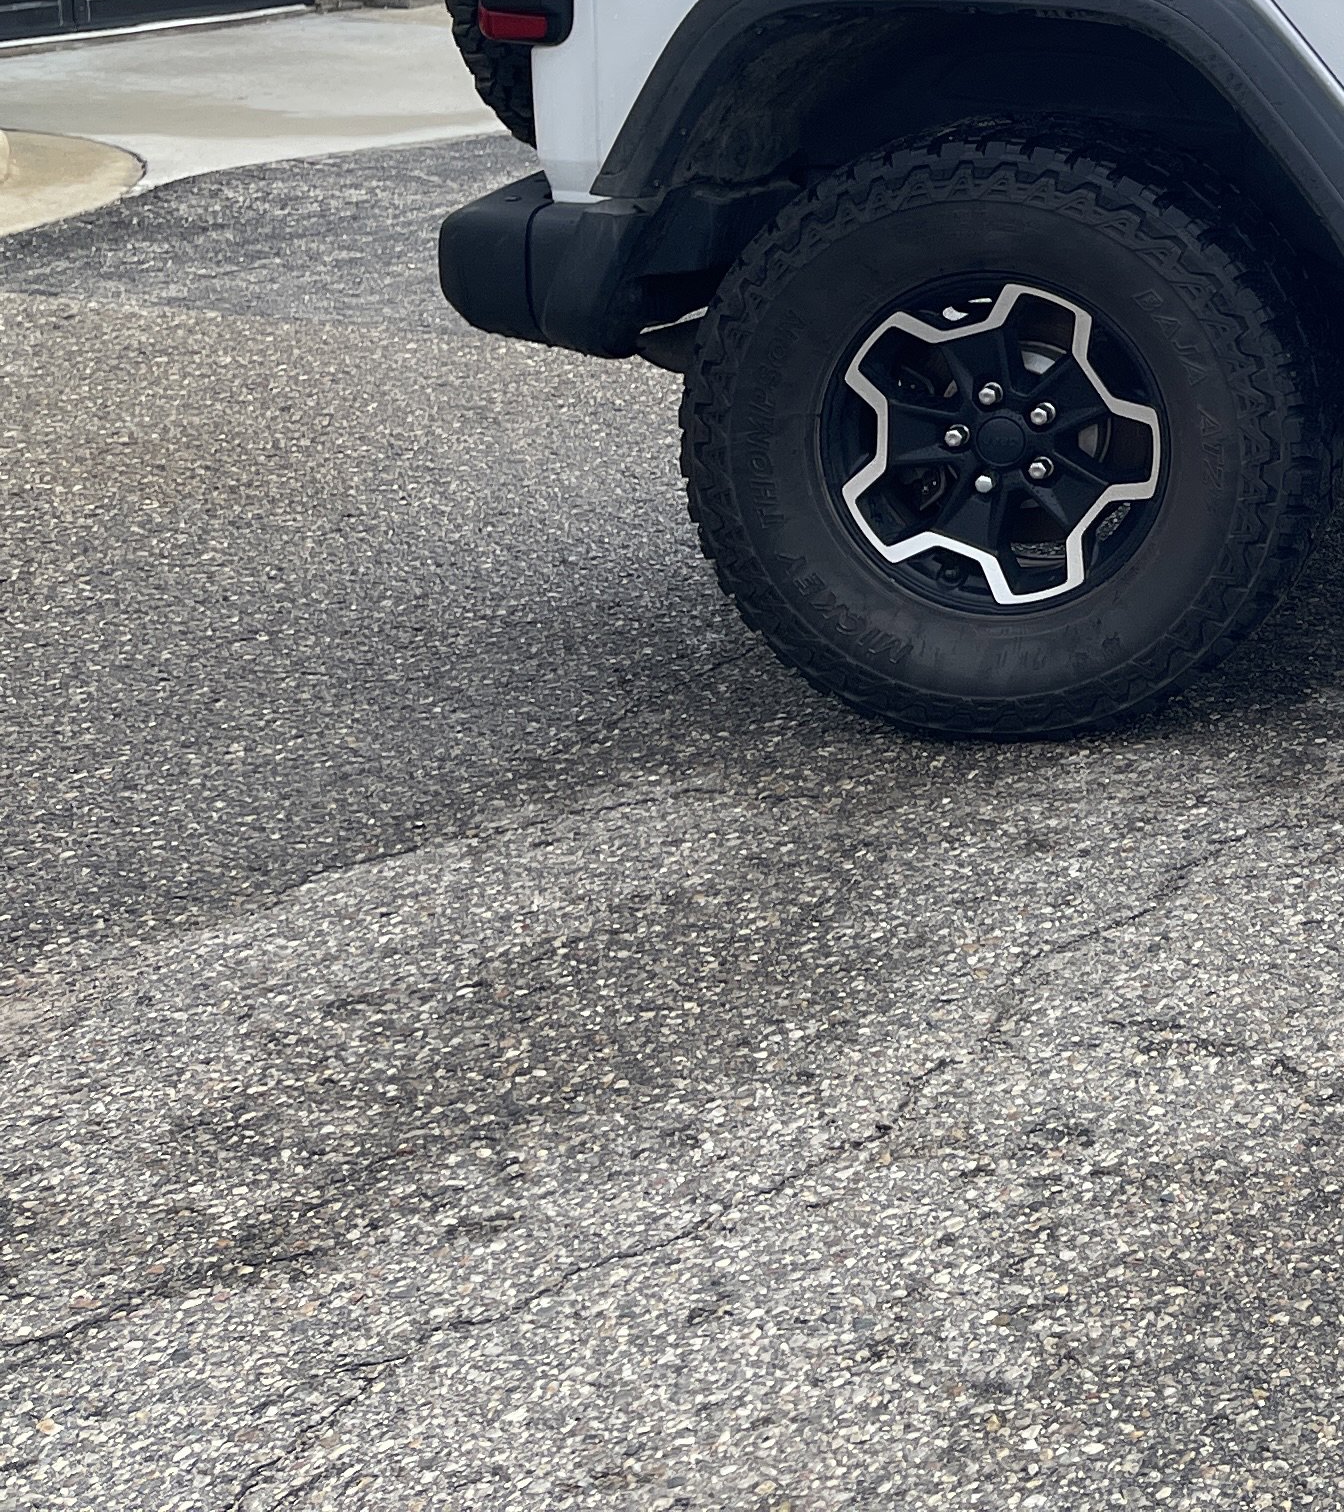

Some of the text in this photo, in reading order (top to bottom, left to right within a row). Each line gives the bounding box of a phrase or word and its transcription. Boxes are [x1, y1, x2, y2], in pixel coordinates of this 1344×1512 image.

[1130, 286, 1210, 388] BAJA
[744, 307, 913, 664] MICKEY THOMPSON
